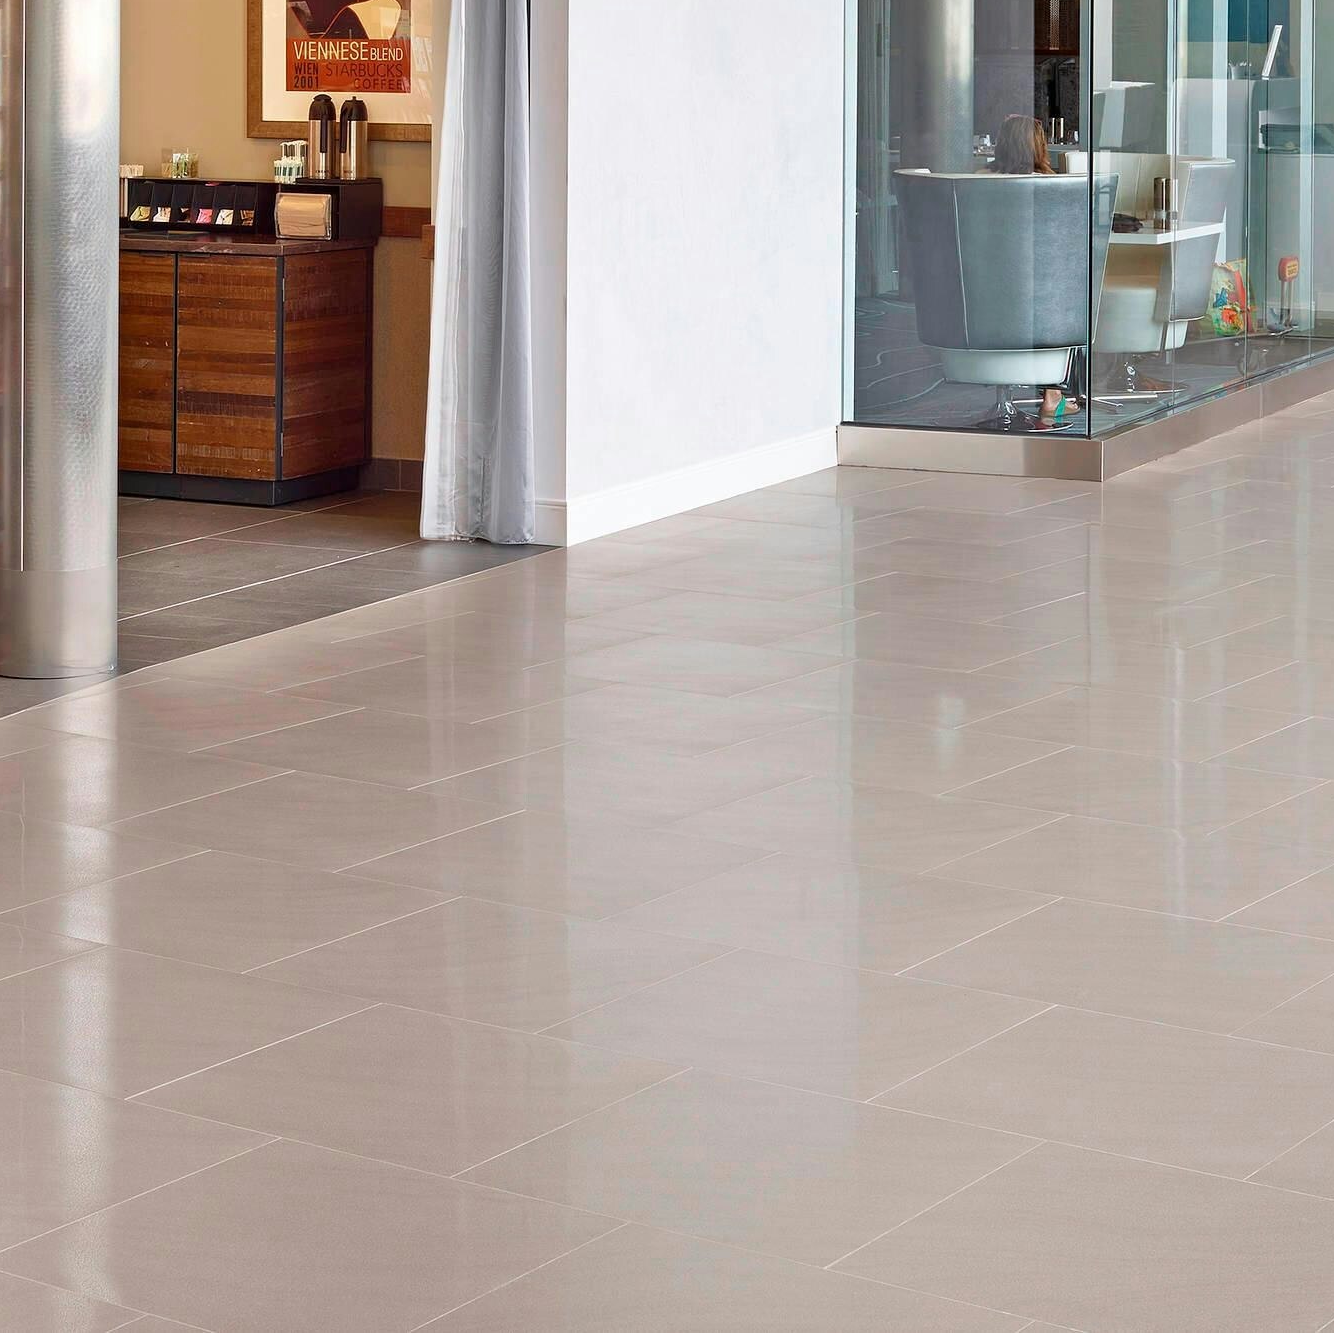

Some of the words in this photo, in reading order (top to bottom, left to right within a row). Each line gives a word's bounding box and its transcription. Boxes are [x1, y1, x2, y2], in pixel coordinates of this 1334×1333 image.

[293, 41, 369, 61] VIENNESE
[370, 47, 404, 61] BLEND
[294, 62, 319, 75] WIEN
[325, 62, 404, 77] STARBUCKS
[293, 75, 319, 89] 2001
[354, 77, 404, 91] COFFEE
